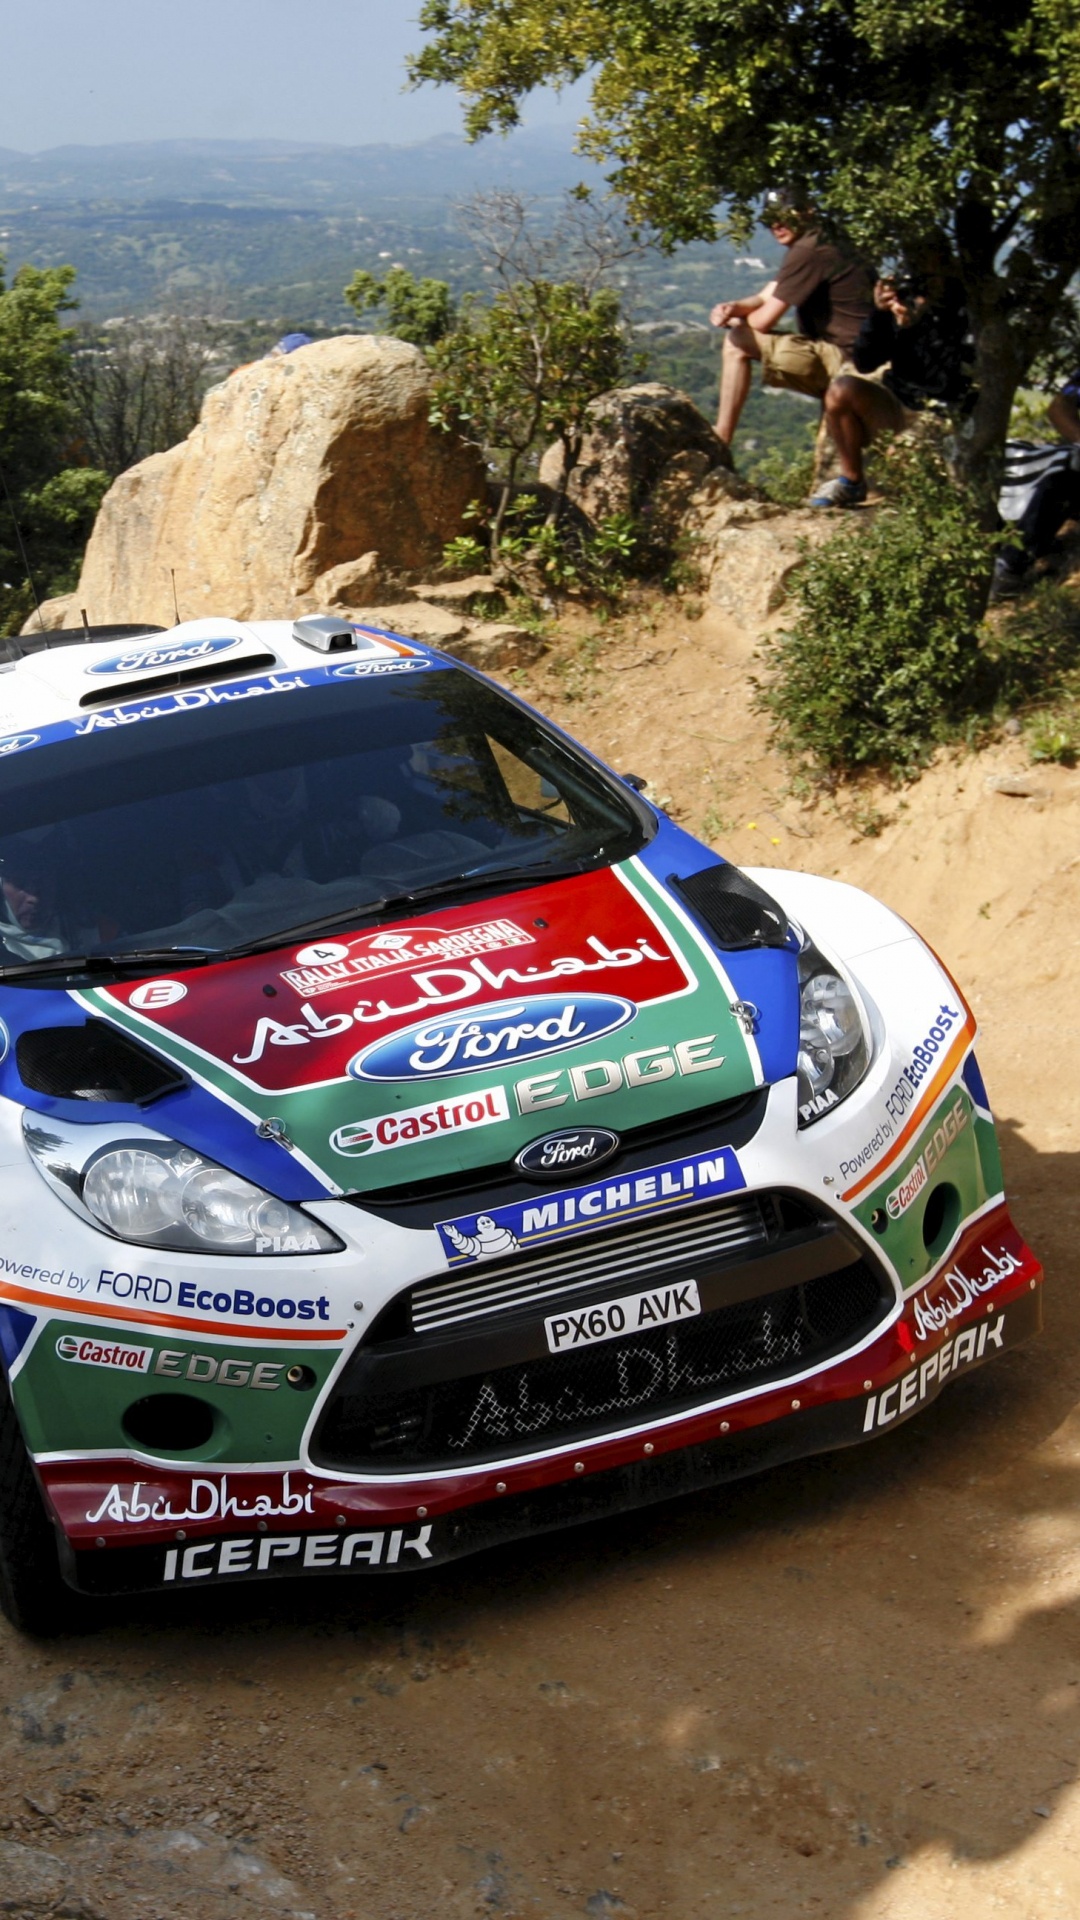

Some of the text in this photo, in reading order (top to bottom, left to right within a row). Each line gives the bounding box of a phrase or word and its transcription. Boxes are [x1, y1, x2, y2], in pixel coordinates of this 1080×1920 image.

[116, 640, 214, 672] Ford
[354, 660, 415, 675] Ford
[288, 962, 352, 988] RALLY
[348, 949, 416, 972] ITALIA
[414, 921, 521, 957] SARDEGNA
[313, 947, 336, 960] 4
[438, 944, 486, 960] 2011
[409, 1004, 585, 1071] Ford
[376, 1034, 727, 1145] Castrol EDGE
[798, 1089, 840, 1121] PIAA
[839, 1004, 959, 1180] Powered by FORD EcoBoost
[541, 1134, 598, 1166] Ford
[898, 1097, 968, 1208] Castrol EDGE
[522, 1158, 725, 1233] MICHELIN
[255, 1235, 322, 1252] PIAA
[67, 1271, 90, 1293] by
[96, 1270, 172, 1303] FORD
[177, 1282, 330, 1320] EcoBoost
[551, 1284, 696, 1348] PX60 AVK
[78, 1341, 287, 1390] Castrol EDGE
[862, 1314, 1005, 1433] ICEPEAK
[163, 1524, 433, 1581] ICEPEAK
